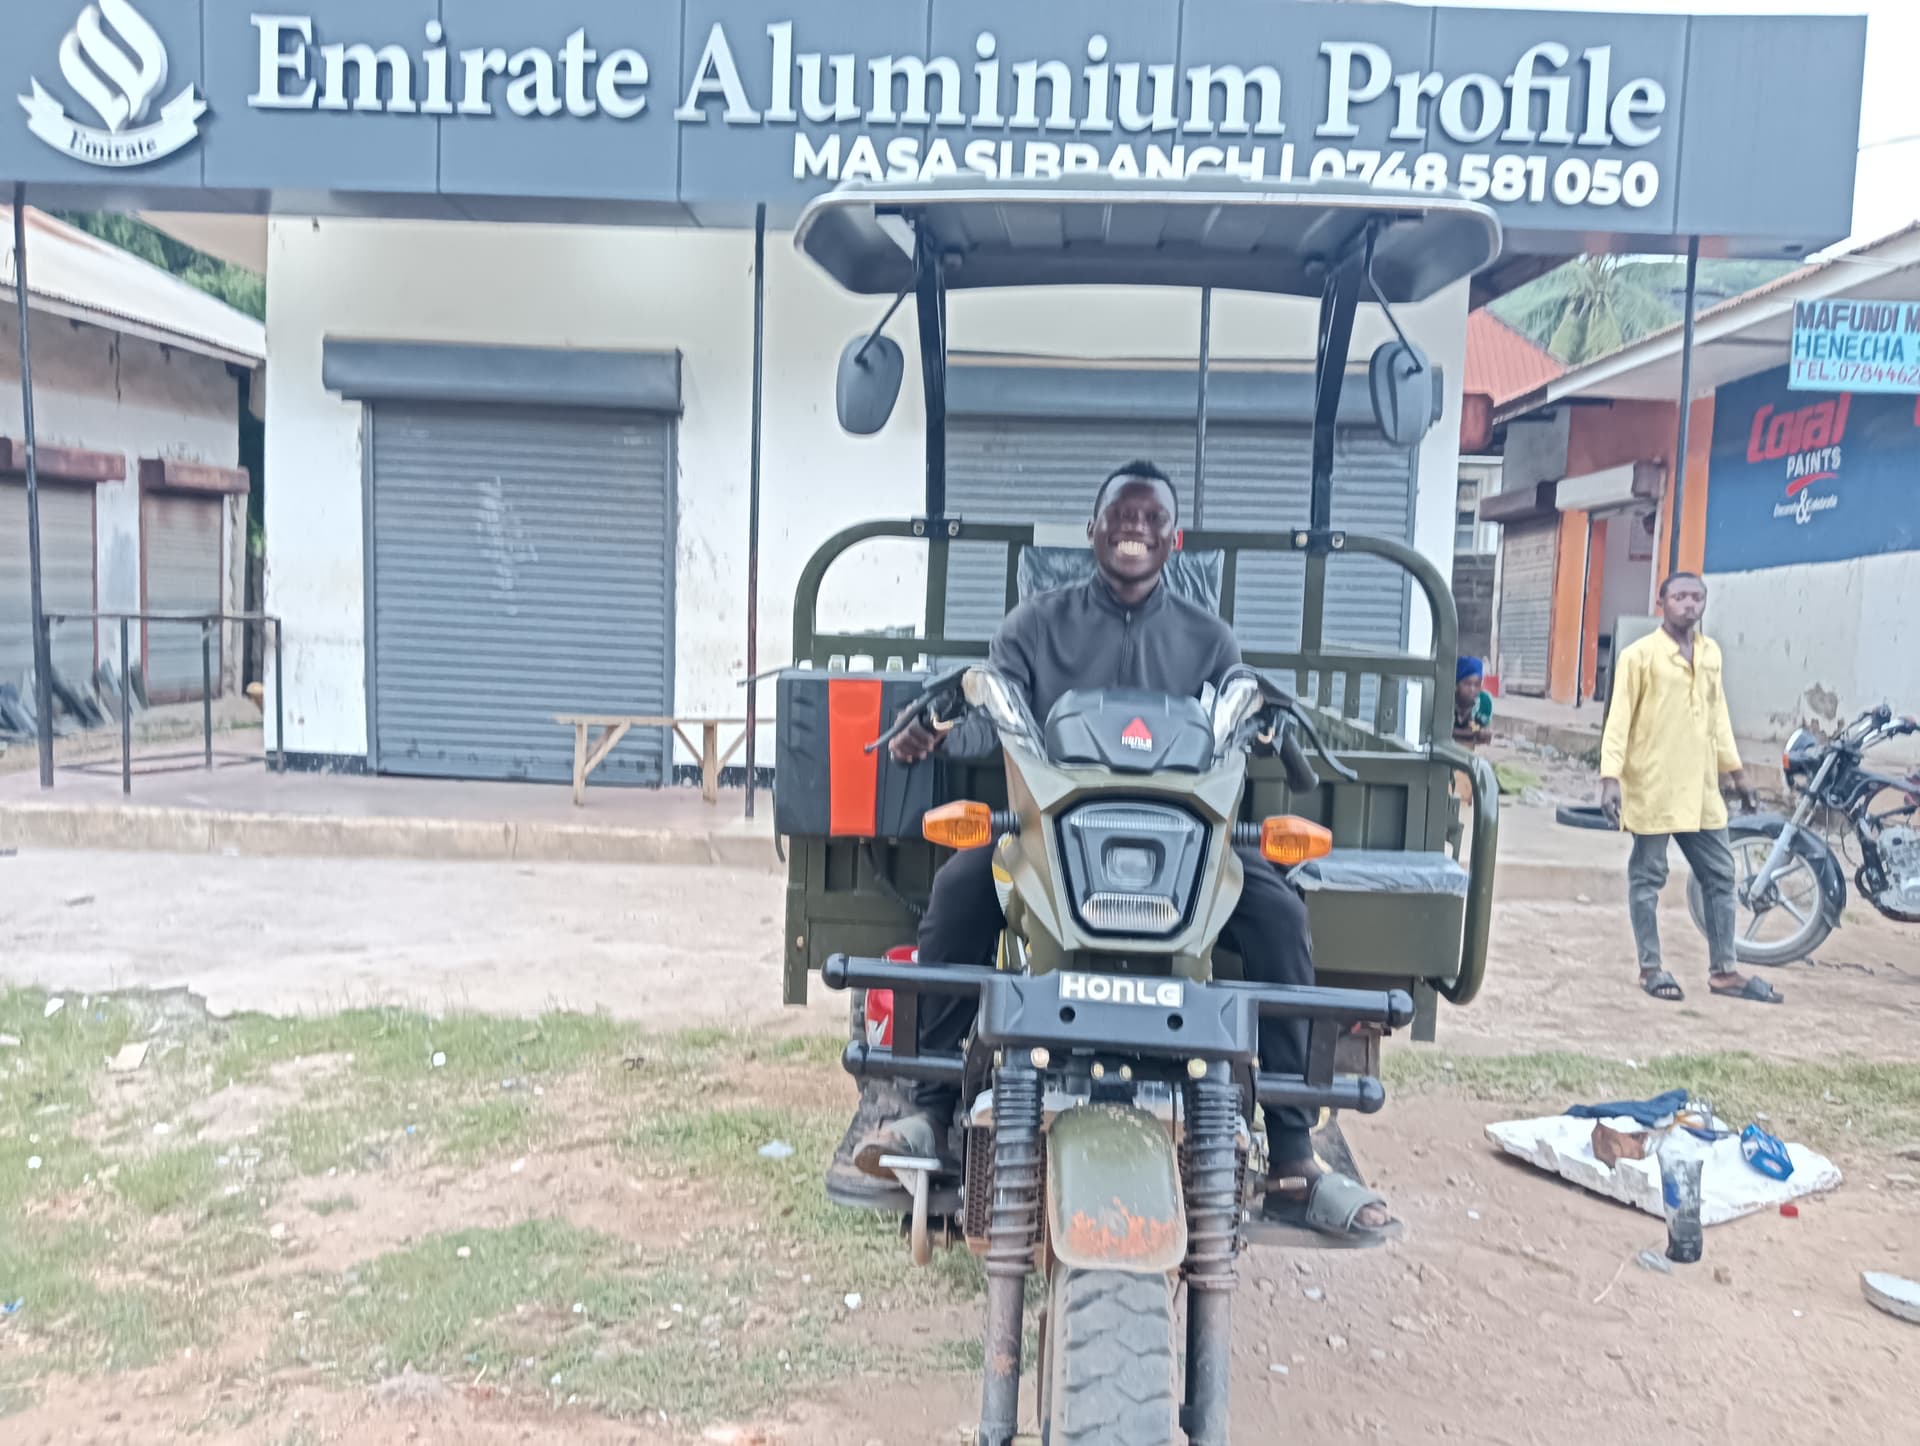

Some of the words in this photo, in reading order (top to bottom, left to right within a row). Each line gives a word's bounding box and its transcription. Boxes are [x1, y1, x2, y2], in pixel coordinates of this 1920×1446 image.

[247, 13, 650, 119] Emirate
[674, 20, 1286, 135] Aluminium
[1315, 41, 1666, 148] Profile
[70, 129, 158, 160] Emirate
[793, 132, 1013, 182] MASASI
[1310, 147, 1449, 192] 0748
[1458, 153, 1548, 202] 581
[1554, 158, 1660, 208] 050
[1795, 302, 1900, 334] MAFUNDI
[1795, 335, 1904, 363] HENECHA
[1747, 391, 1852, 464] Coral
[1787, 446, 1842, 479] PAINTS
